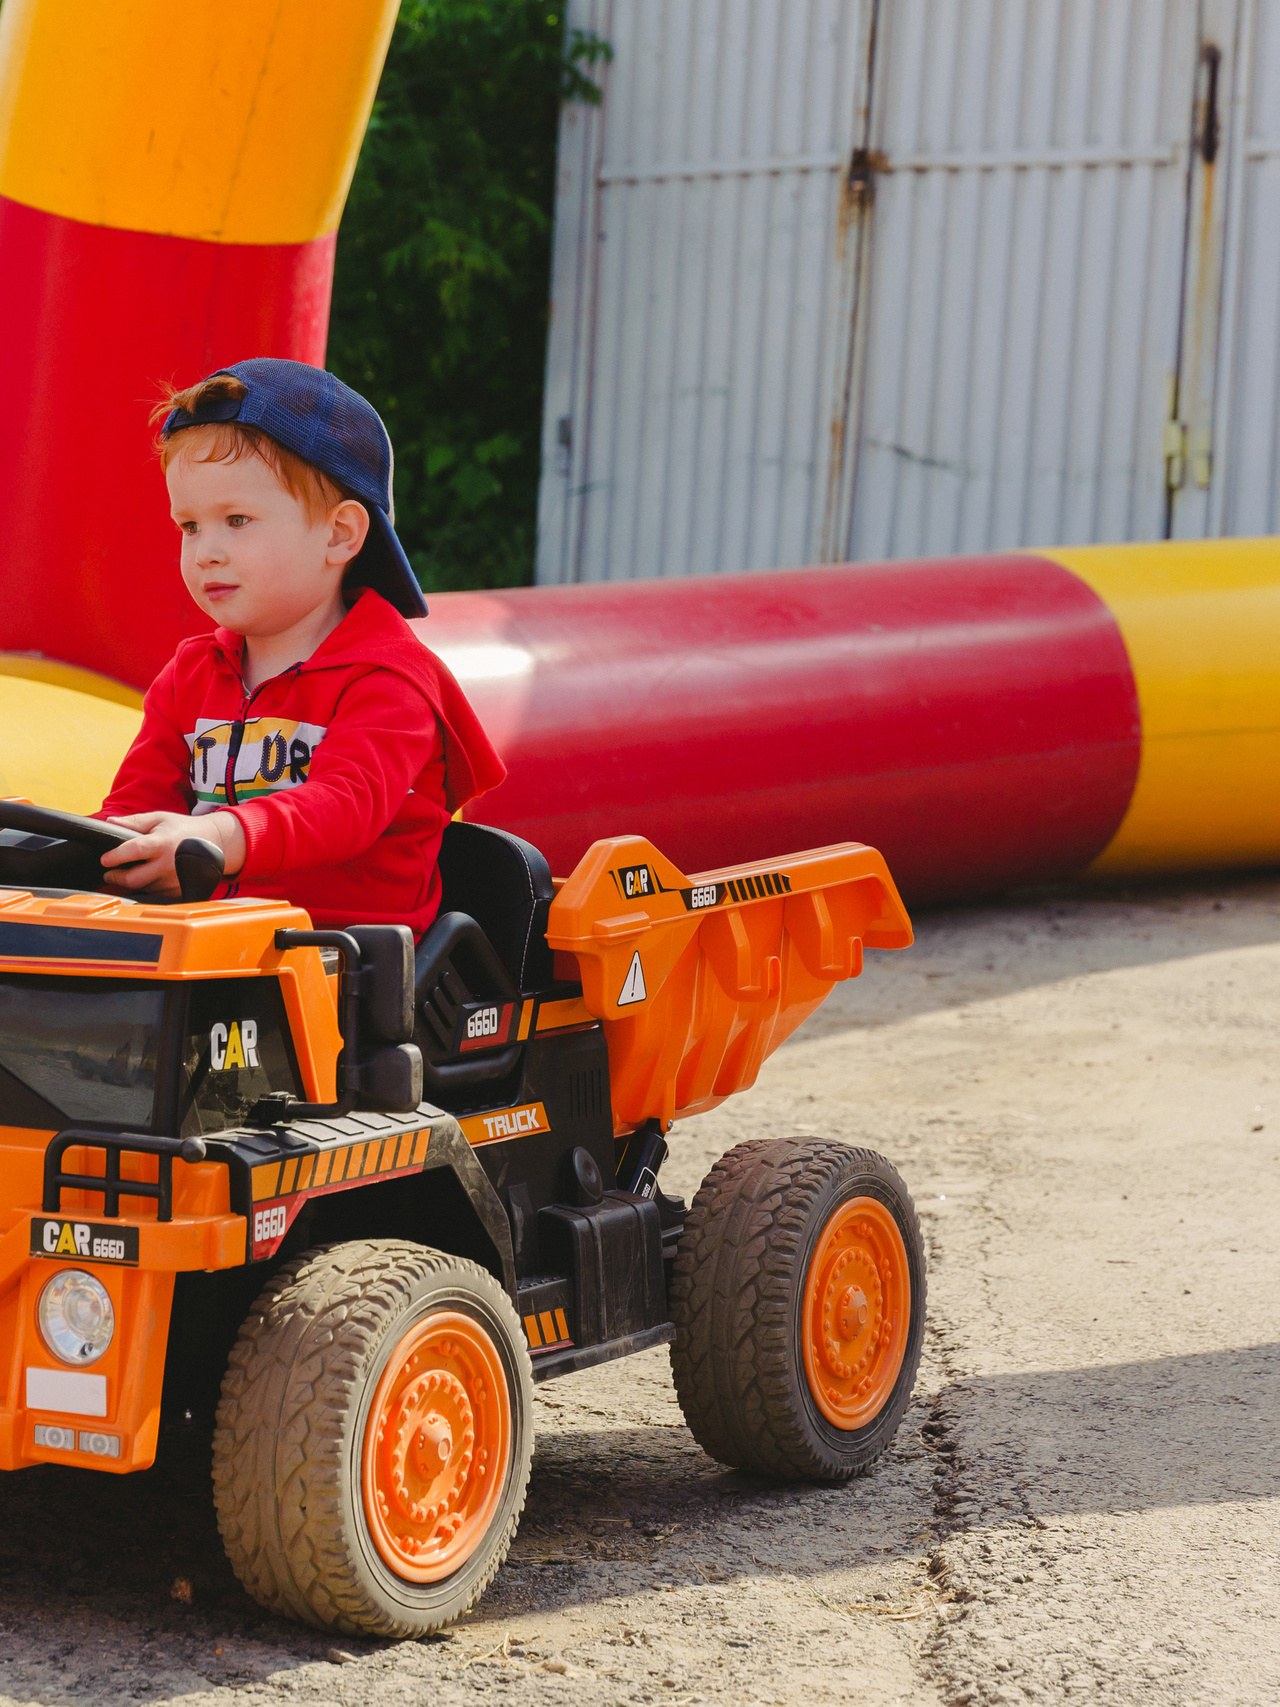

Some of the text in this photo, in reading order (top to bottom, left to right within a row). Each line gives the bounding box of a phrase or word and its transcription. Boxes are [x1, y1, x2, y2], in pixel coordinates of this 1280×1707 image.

[626, 868, 648, 895] CAR
[210, 1019, 259, 1071] CAR
[483, 1107, 540, 1138] TRUCK
[43, 1221, 91, 1256] CAR
